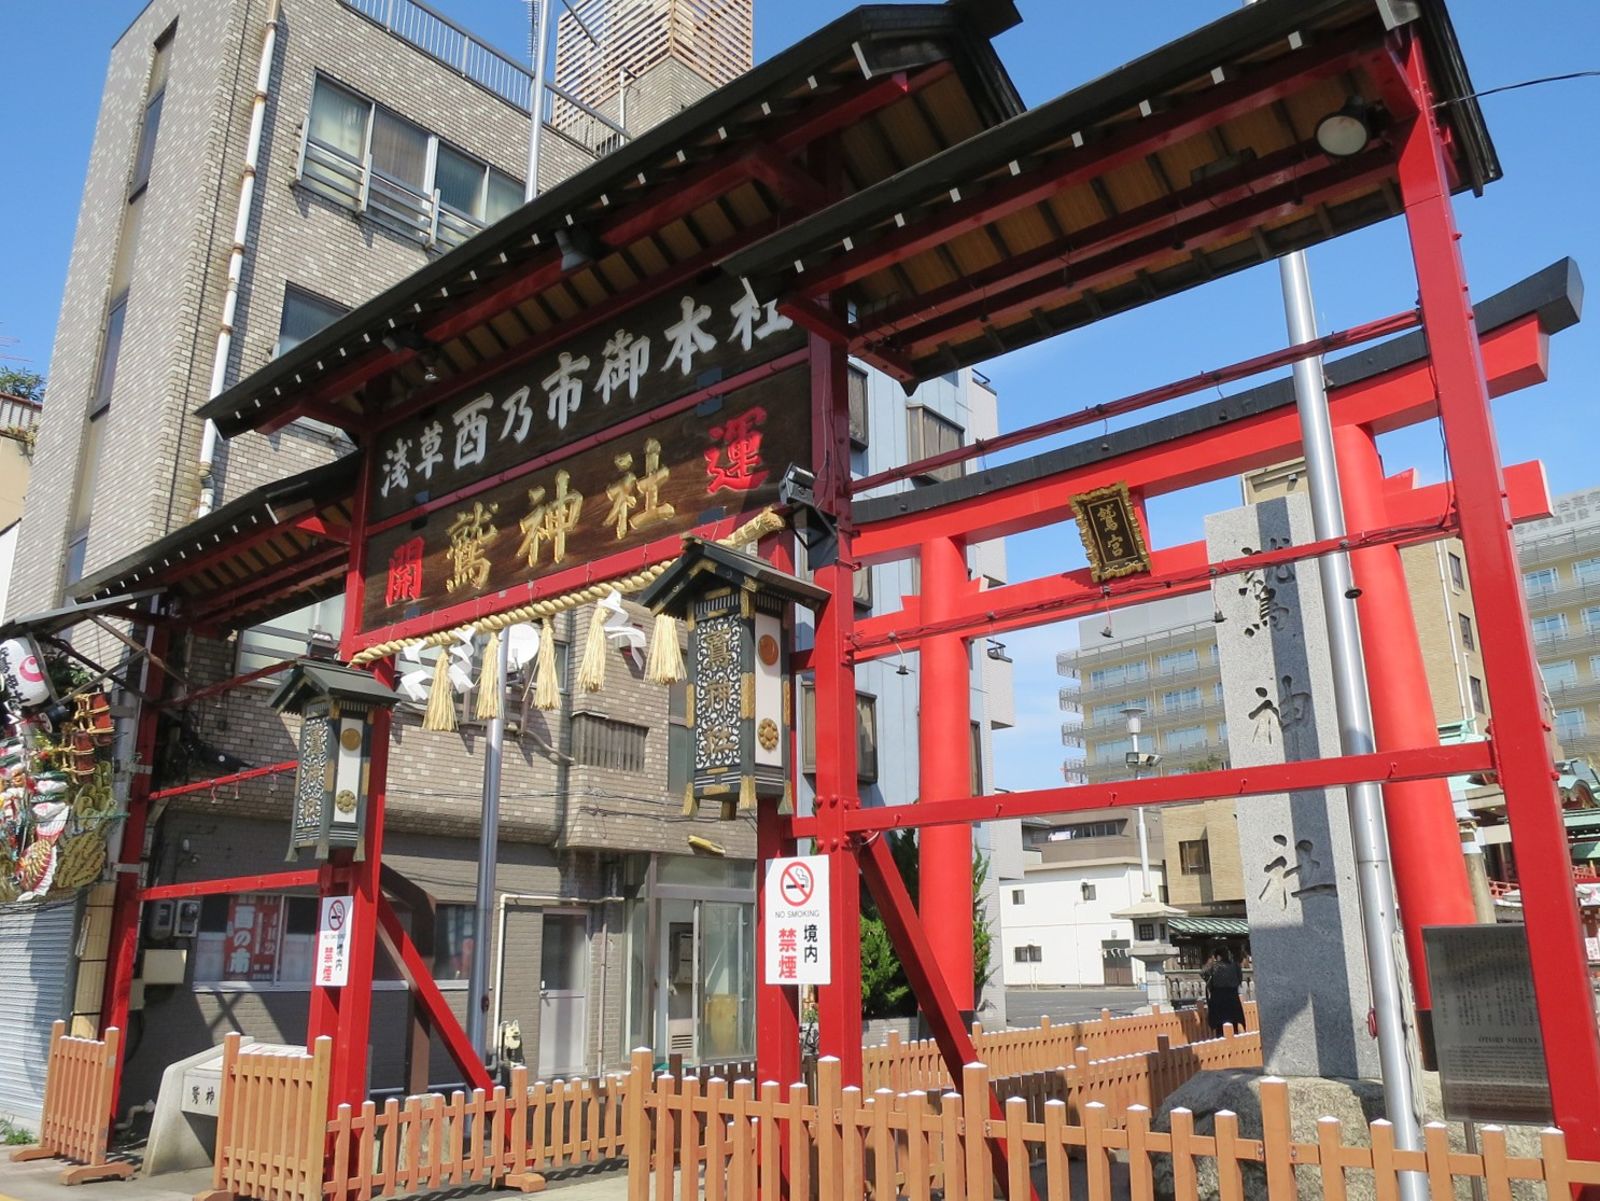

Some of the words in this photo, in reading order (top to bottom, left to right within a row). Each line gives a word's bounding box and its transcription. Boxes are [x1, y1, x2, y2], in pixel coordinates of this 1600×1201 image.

[446, 437, 675, 594] 鷲神社
[703, 406, 770, 495] 運
[787, 910, 820, 918] SMOKING
[778, 928, 797, 979] 禁煙
[804, 924, 818, 963] 境内
